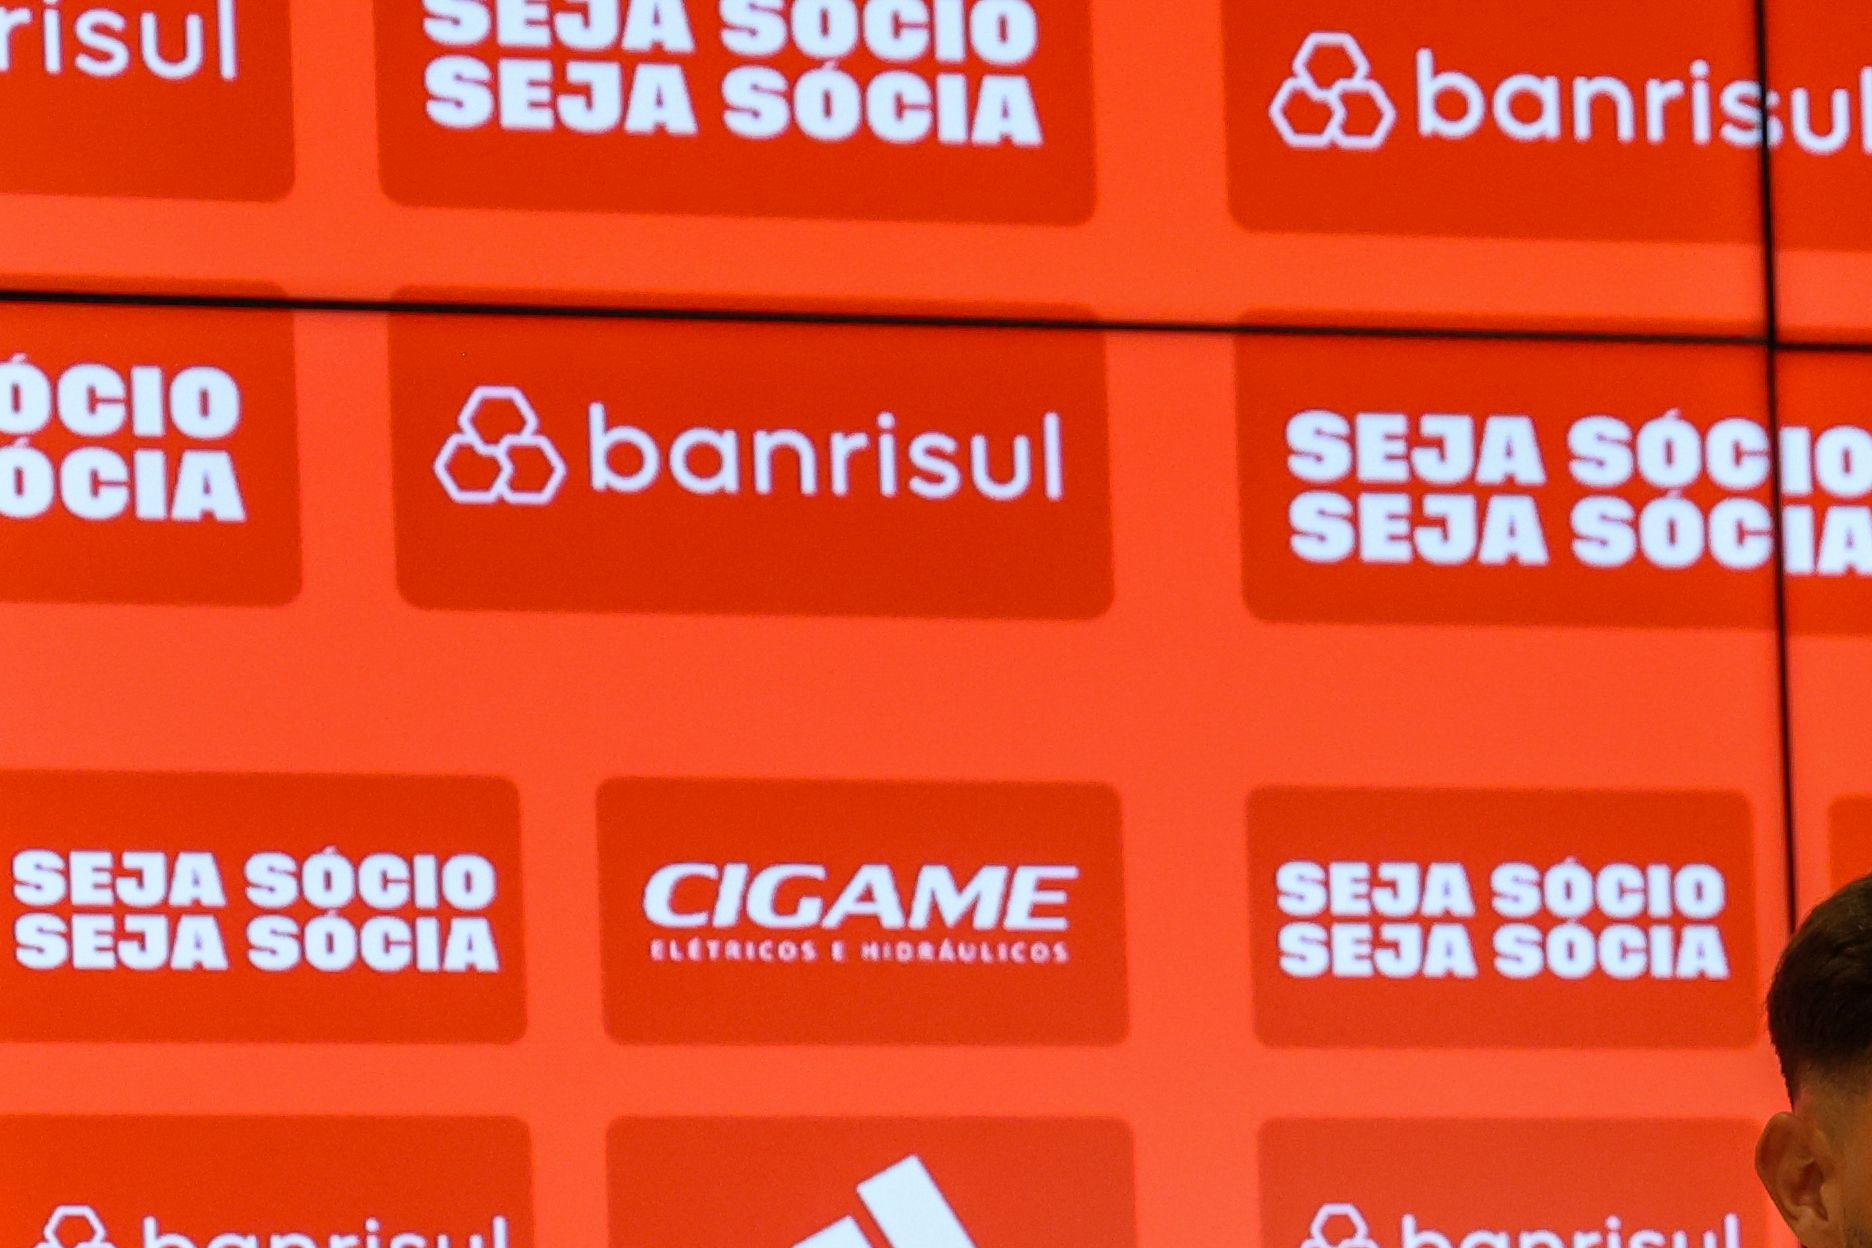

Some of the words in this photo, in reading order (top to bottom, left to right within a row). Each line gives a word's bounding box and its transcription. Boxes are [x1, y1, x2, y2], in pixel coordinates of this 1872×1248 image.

[0, 0, 237, 80] risul
[422, 0, 695, 54] SEJA
[425, 54, 698, 135] SEJA
[722, 60, 1043, 145] SÓCIA
[0, 353, 241, 439] ÓCIO
[0, 437, 246, 522] ÓCIA
[589, 402, 1063, 500] banrisul
[1286, 410, 1546, 486] SEJA
[1289, 491, 1549, 566] SEJA
[13, 849, 227, 908] SEJA
[244, 846, 497, 910] SÓCIO
[643, 863, 1079, 931] CIGAME
[1276, 861, 1475, 918] SEJA
[1491, 857, 1725, 918] SÓCIO
[15, 913, 229, 970] SEJA
[246, 907, 499, 972] SÓCIA
[651, 938, 818, 961] ELÉTRICOS
[832, 941, 844, 961] E
[861, 939, 1068, 963] HIDRÁULICOS
[1279, 922, 1478, 978] SEJA
[1493, 916, 1729, 979] SÓCIA
